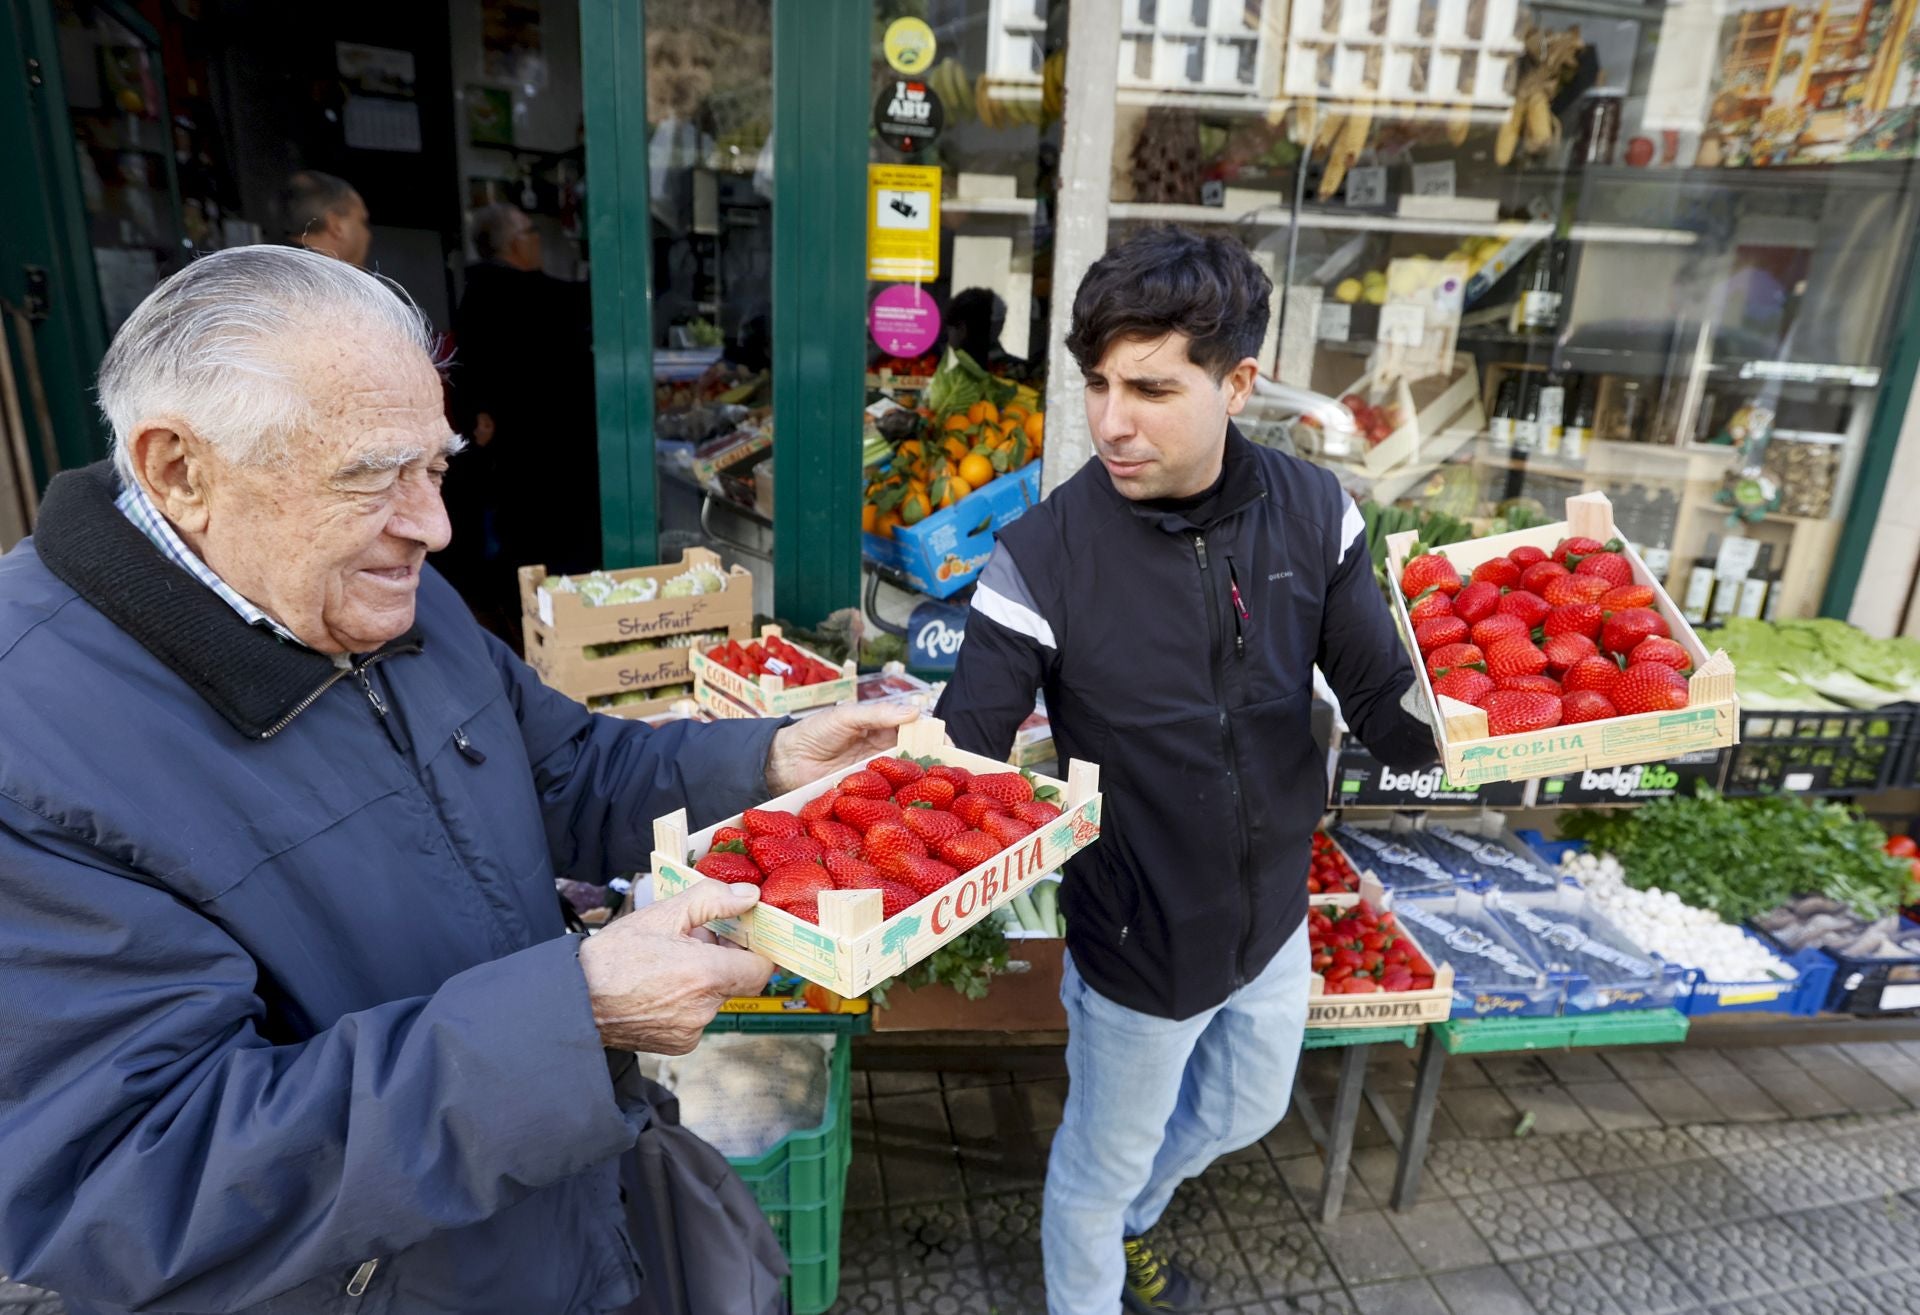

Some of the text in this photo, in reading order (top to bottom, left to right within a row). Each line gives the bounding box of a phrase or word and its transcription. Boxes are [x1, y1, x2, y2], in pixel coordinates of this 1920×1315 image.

[618, 611, 693, 634] StarFruit
[1497, 734, 1584, 759] COBITA
[1580, 764, 1679, 797] belgibio
[931, 837, 1043, 935] COBITA
[1309, 1002, 1422, 1020] HOLANDITA
